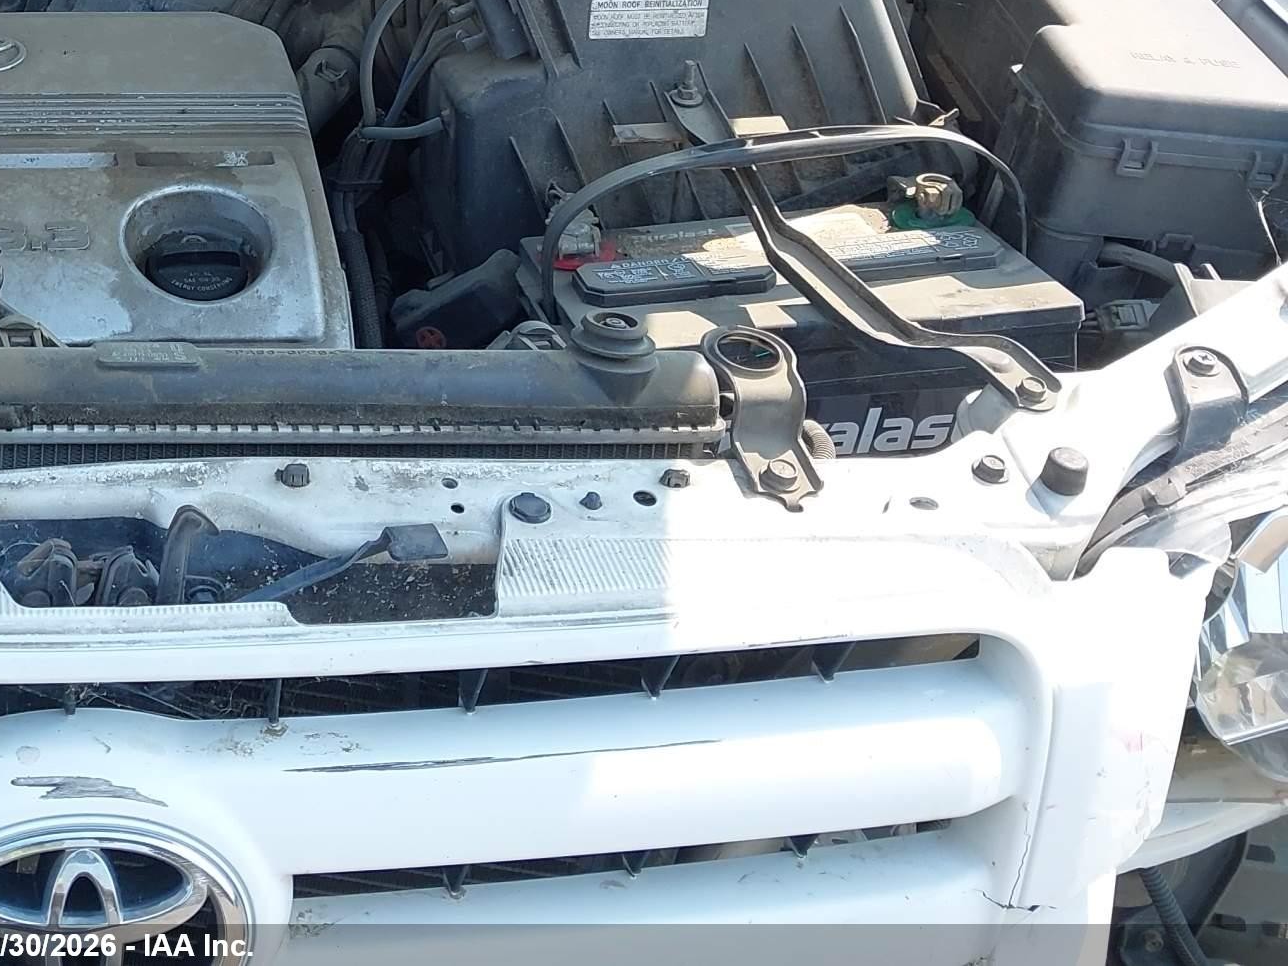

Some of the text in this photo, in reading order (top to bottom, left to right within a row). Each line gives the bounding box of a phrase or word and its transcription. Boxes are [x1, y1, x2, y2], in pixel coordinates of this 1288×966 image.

[597, 0, 618, 9] MOON
[621, 0, 641, 8] ROOF
[821, 407, 961, 455] alas
